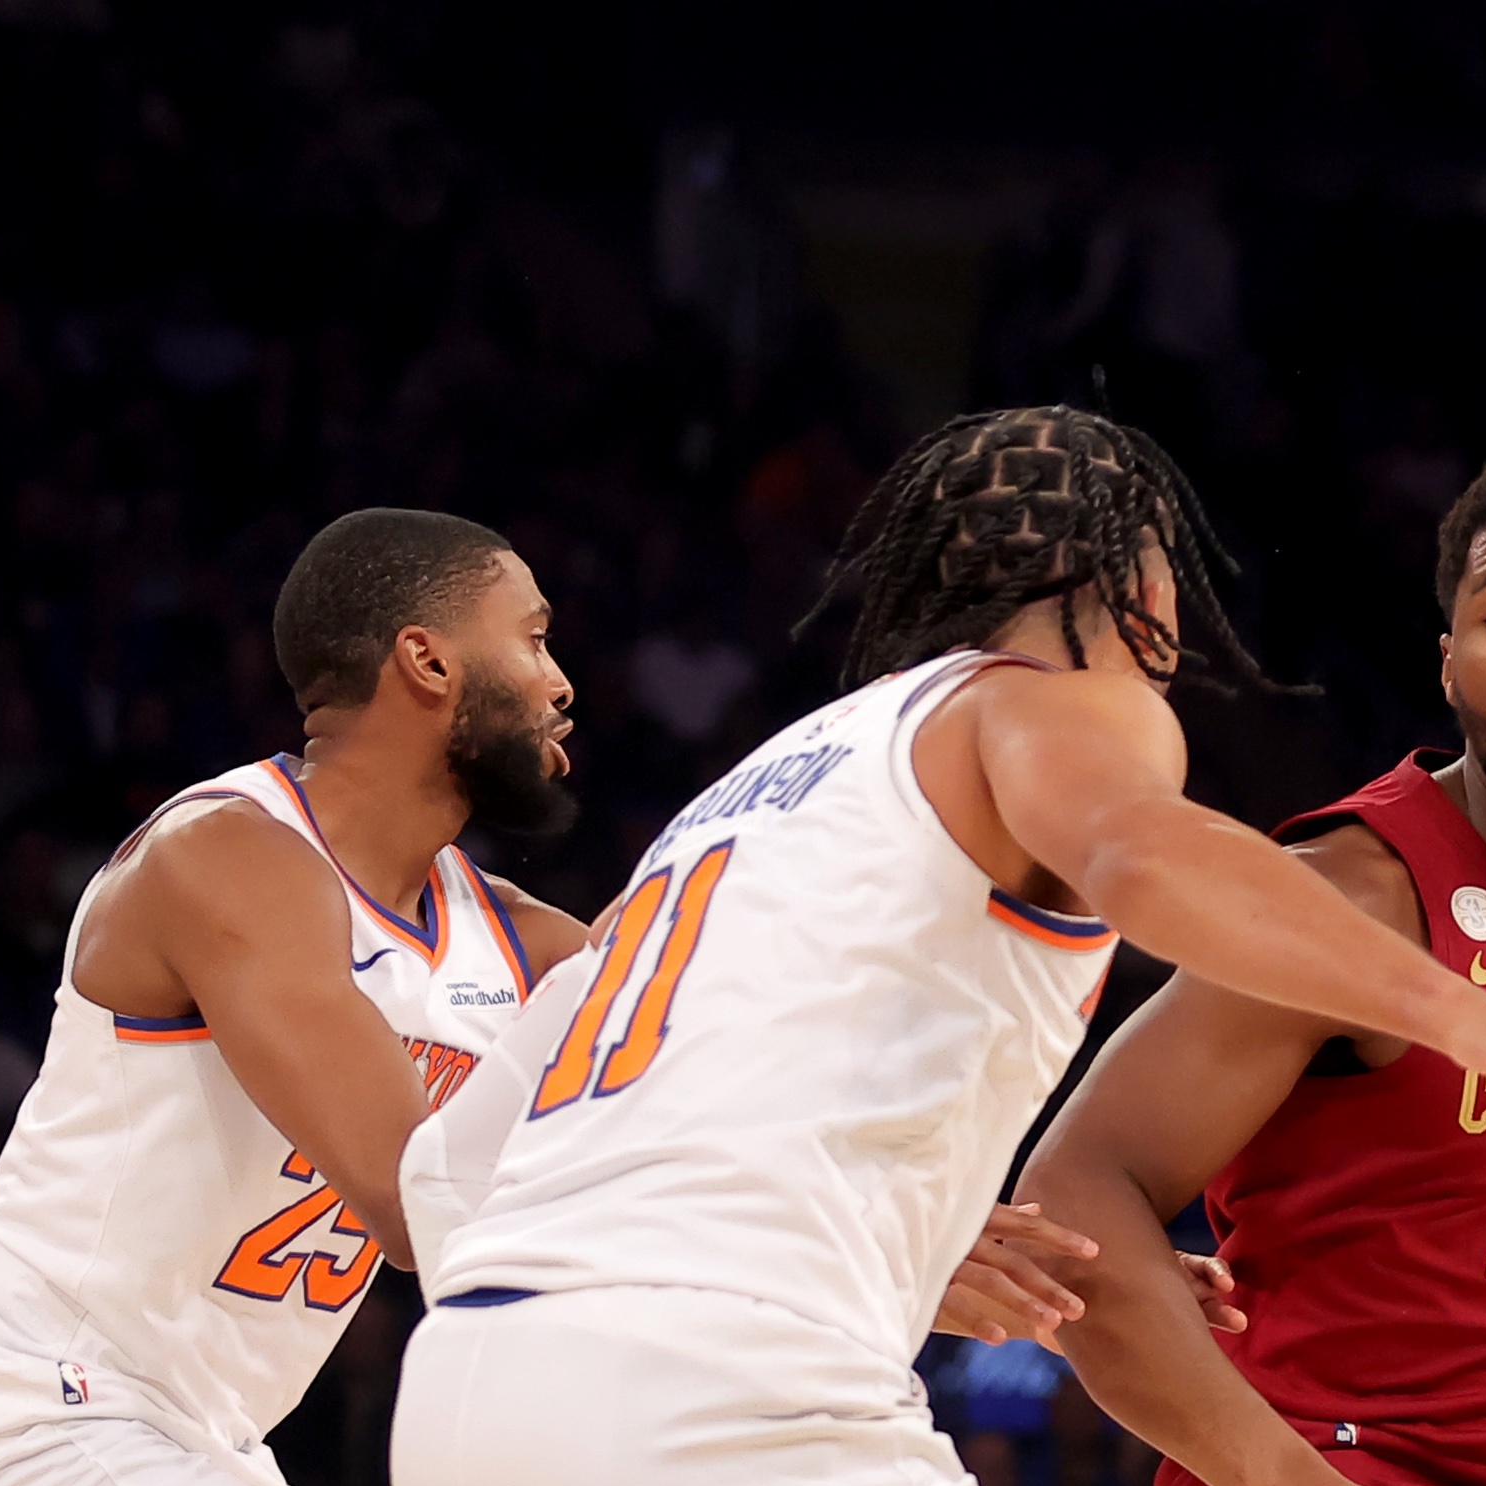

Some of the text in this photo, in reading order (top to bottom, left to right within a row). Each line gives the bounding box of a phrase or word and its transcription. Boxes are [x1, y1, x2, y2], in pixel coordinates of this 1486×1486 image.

[450, 987, 516, 1006] abu dhabi
[528, 836, 736, 1121] 11
[212, 1147, 385, 1313] 25
